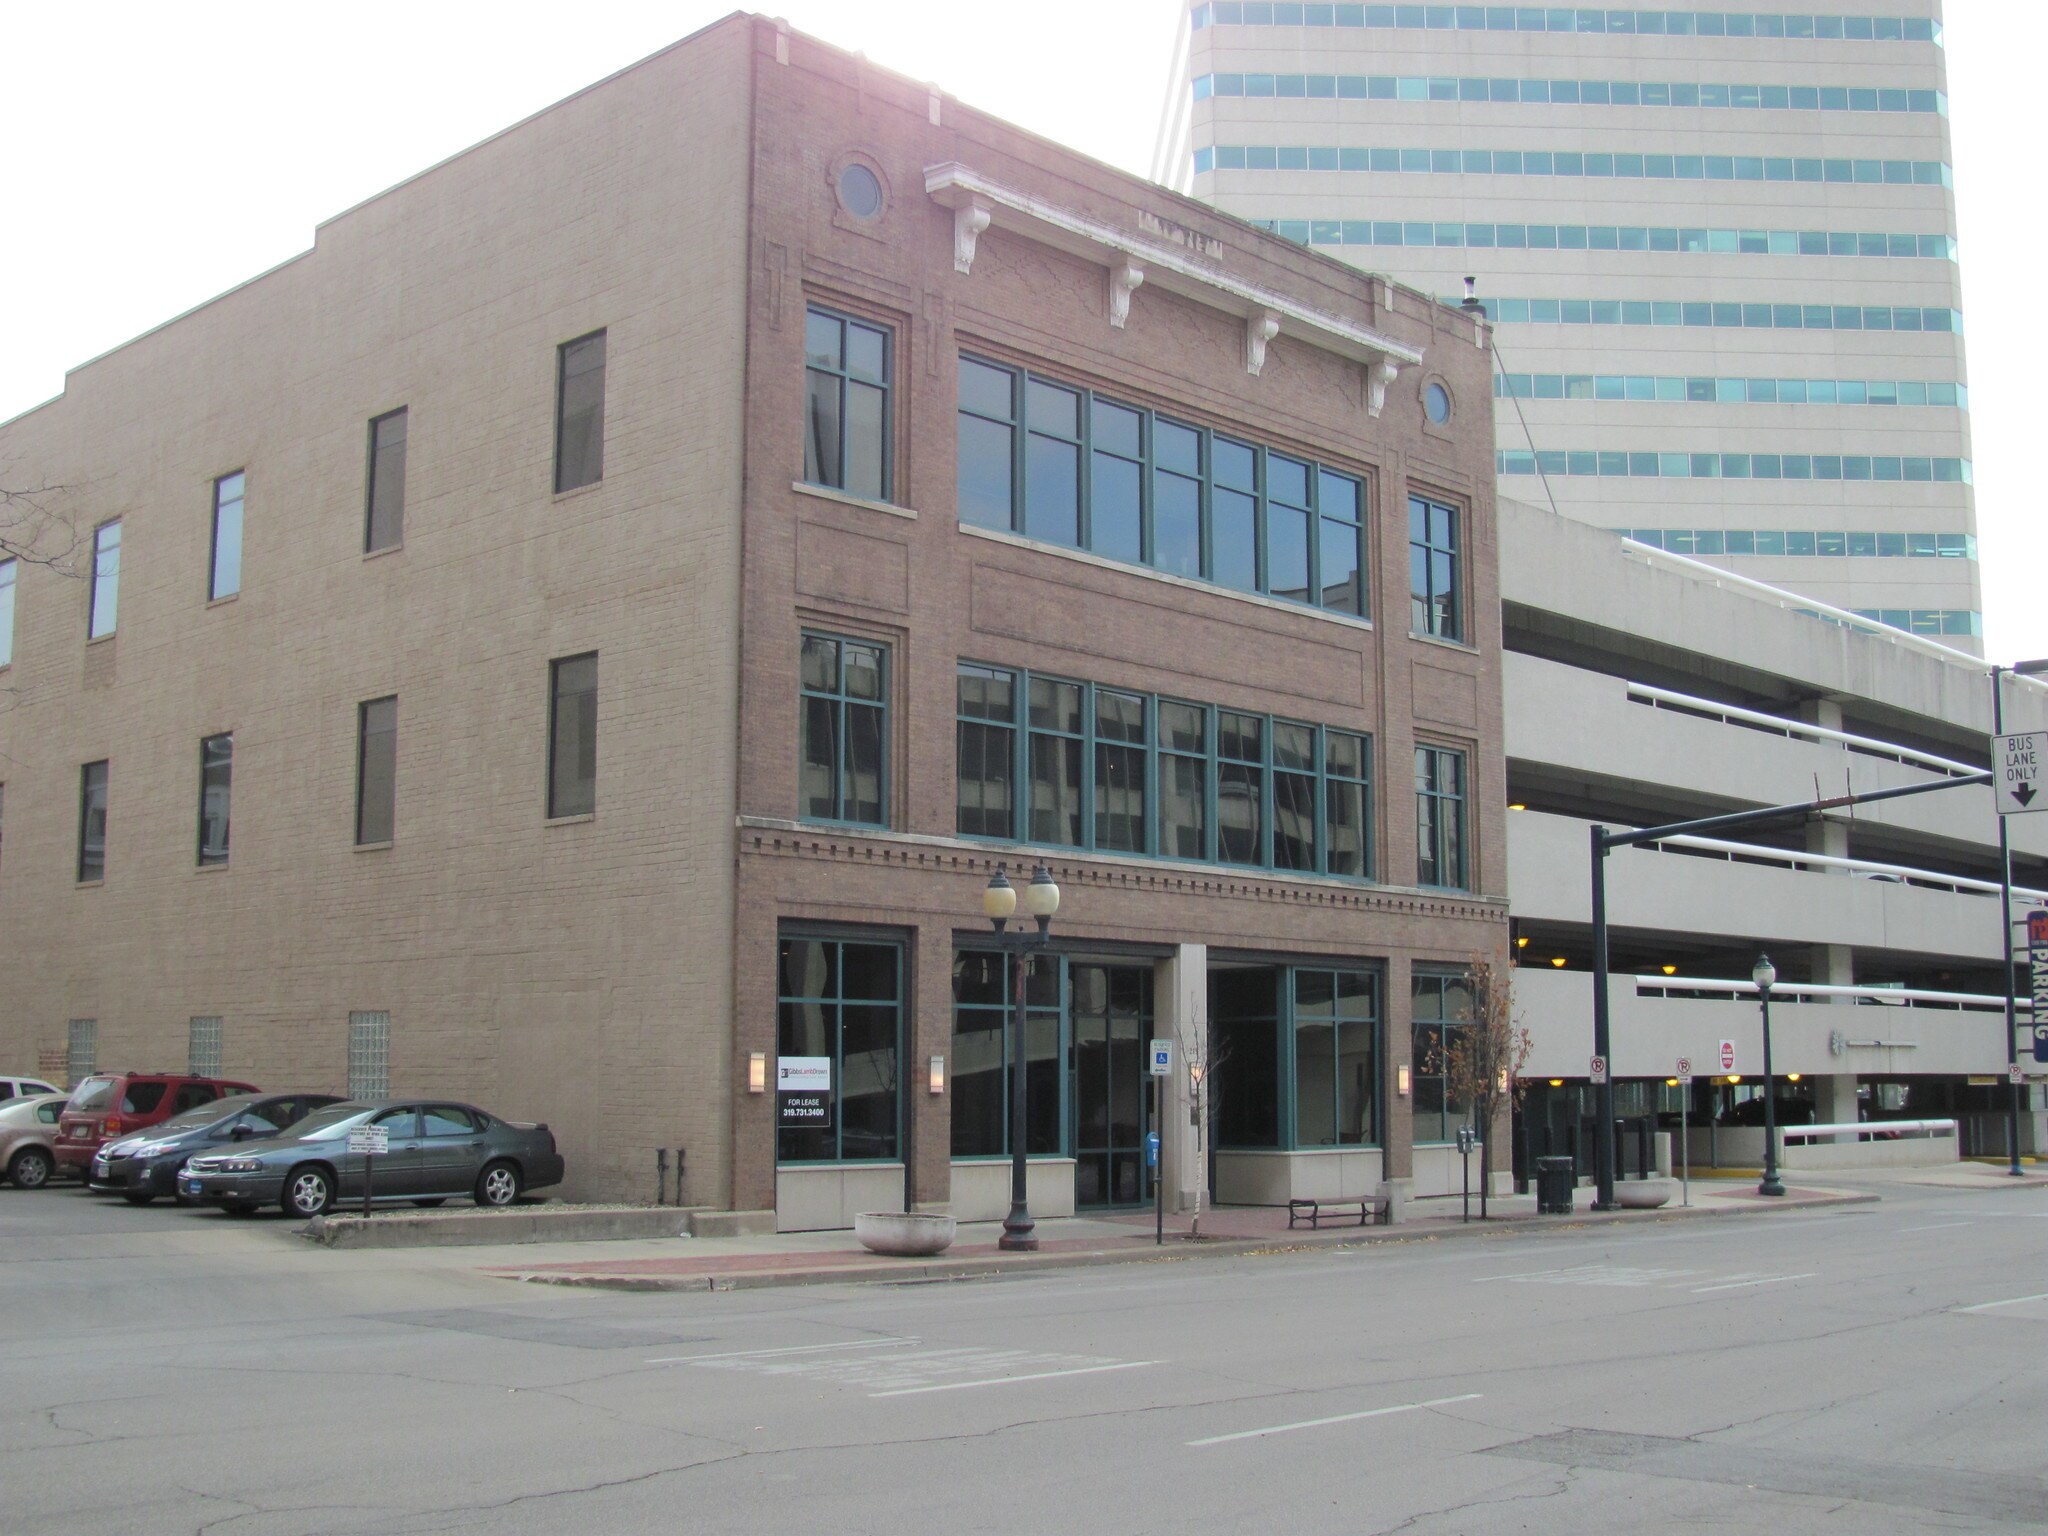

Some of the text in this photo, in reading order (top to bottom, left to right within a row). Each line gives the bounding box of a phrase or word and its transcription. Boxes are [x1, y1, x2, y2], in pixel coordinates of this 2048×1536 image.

[2008, 737, 2033, 751] BUS
[2006, 752, 2037, 766] LANE
[2006, 767, 2037, 781] ONLY
[2031, 948, 2048, 1041] PARKING
[788, 1098, 820, 1106] FOR LEASE
[783, 1108, 825, 1116] 319.731.3400
